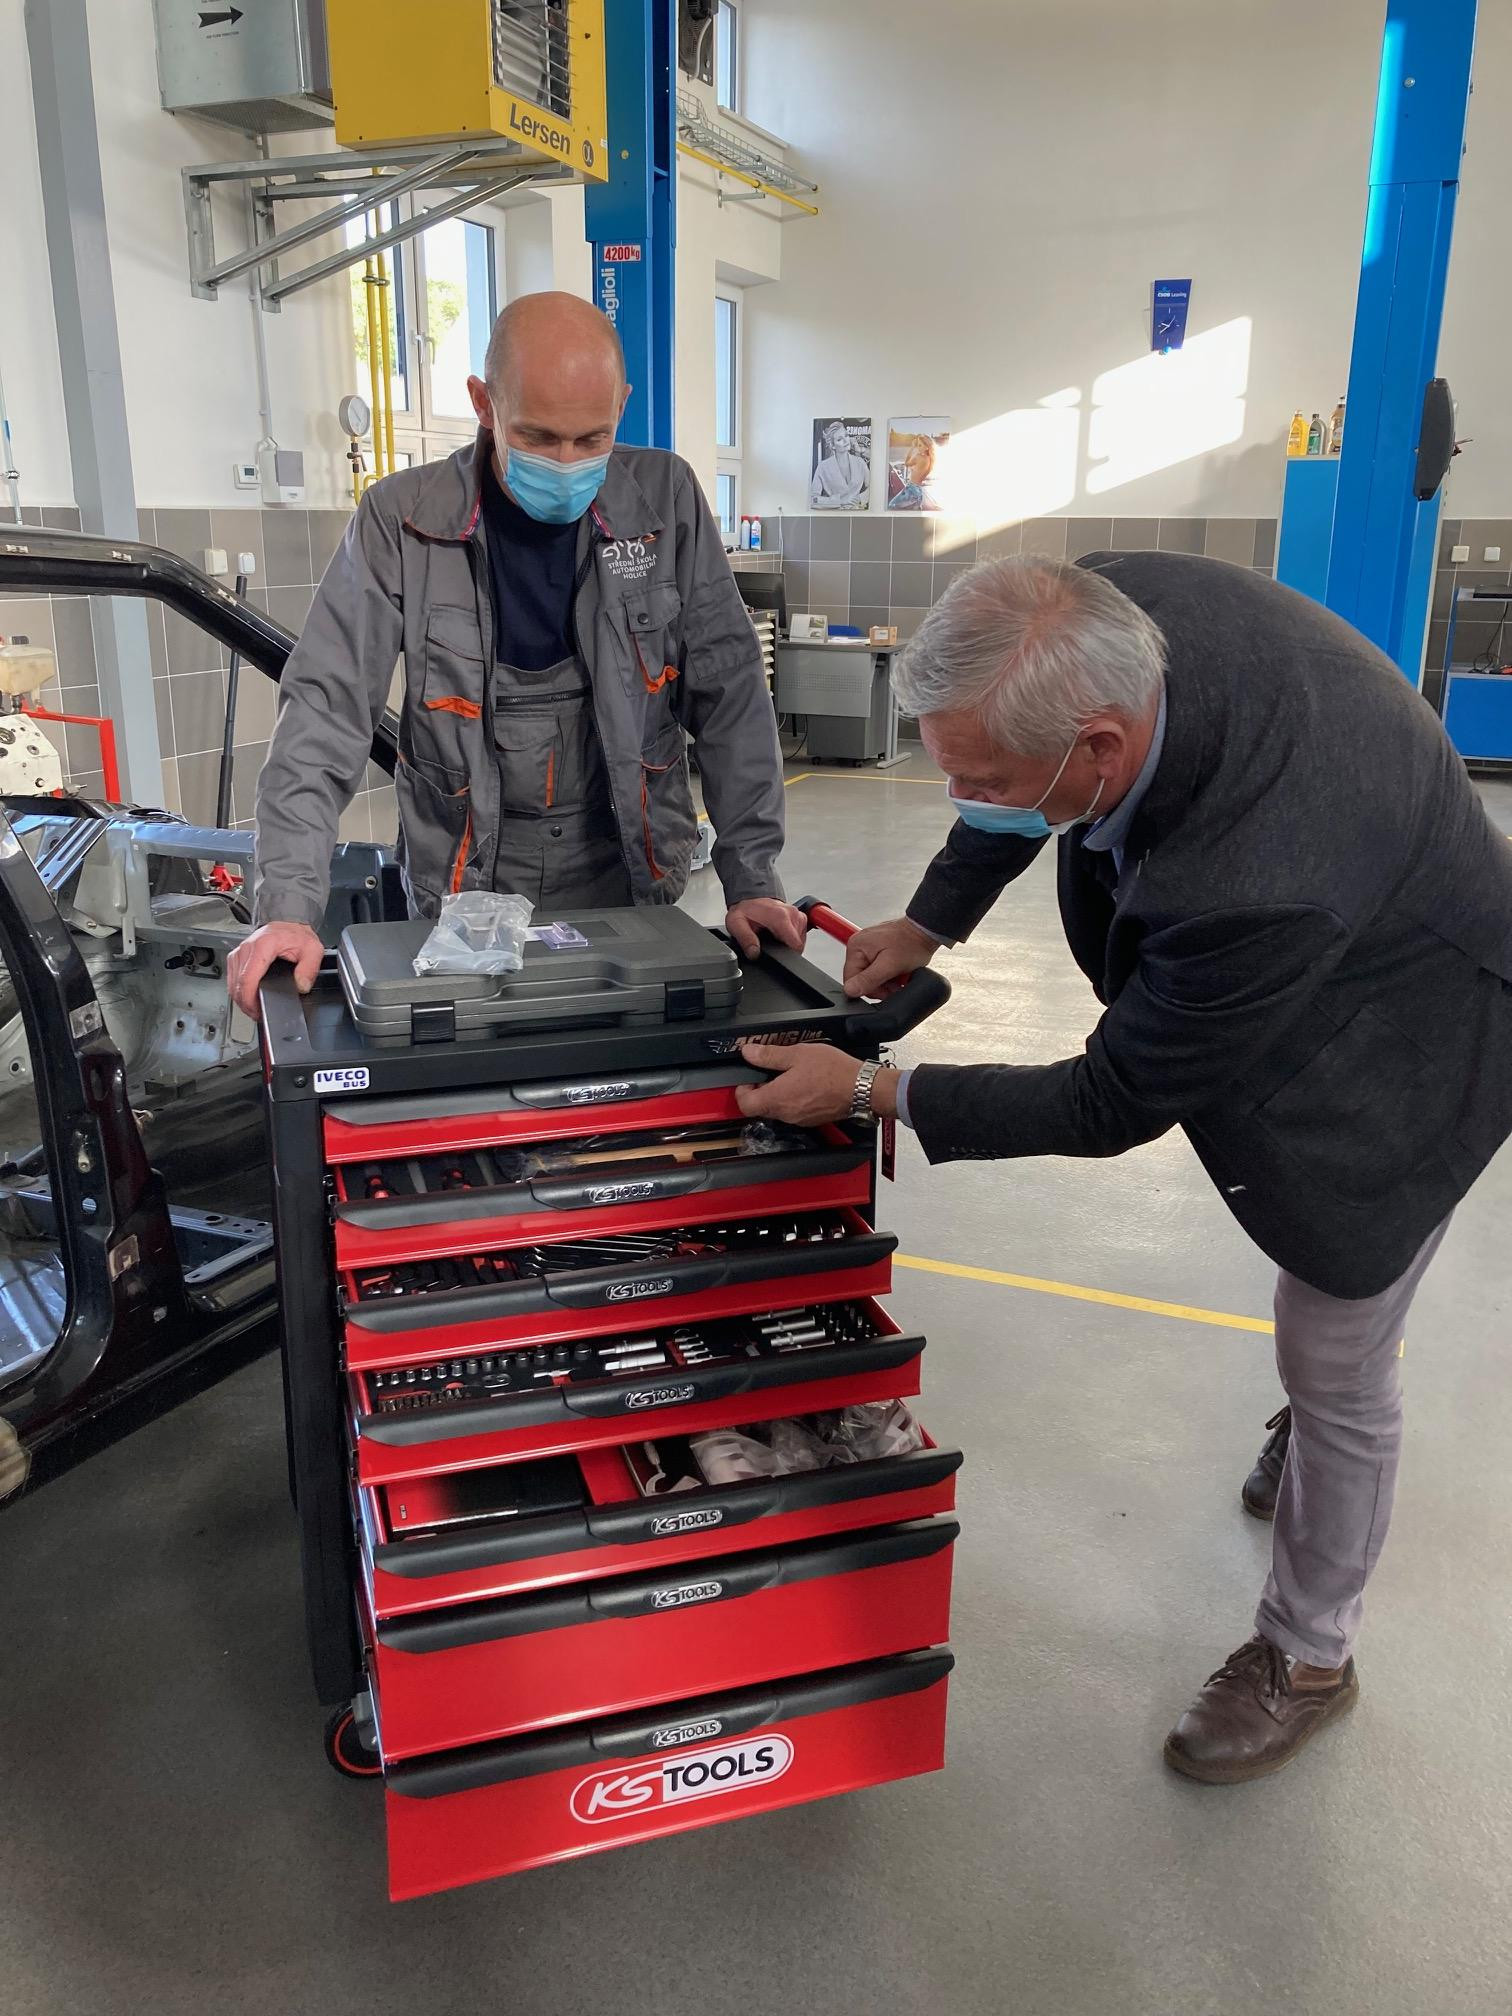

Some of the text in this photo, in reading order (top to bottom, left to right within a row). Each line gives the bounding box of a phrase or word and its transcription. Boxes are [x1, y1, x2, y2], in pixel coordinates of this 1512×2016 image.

[510, 103, 571, 155] Lersen
[601, 267, 620, 329] aglioli
[623, 571, 647, 579] HOLICE
[317, 1070, 366, 1083] IVECO
[343, 1080, 366, 1088] BUS
